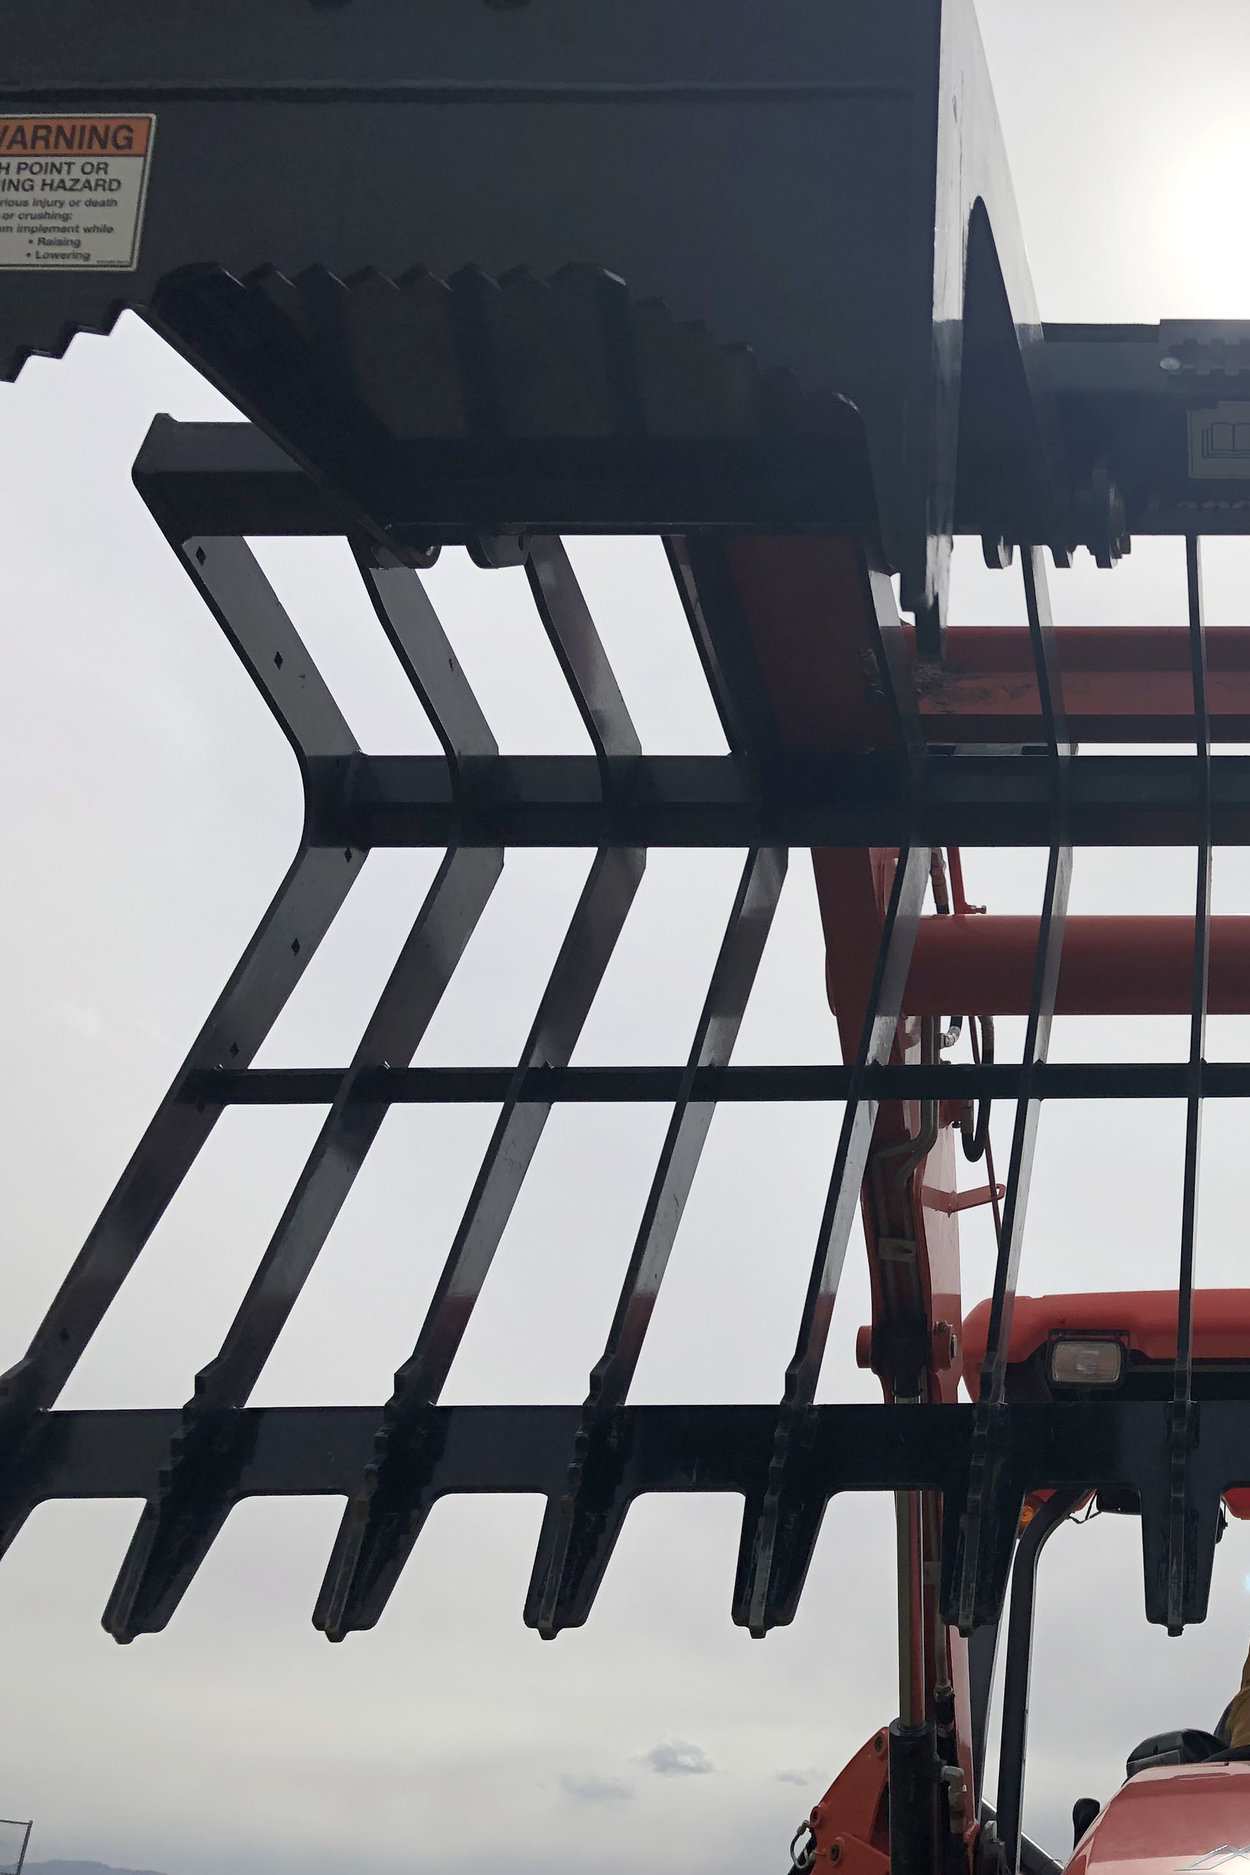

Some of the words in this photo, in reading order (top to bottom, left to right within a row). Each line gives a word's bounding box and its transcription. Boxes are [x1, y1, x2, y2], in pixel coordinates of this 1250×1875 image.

[16, 161, 75, 175] POINT
[81, 161, 109, 175] OR
[41, 178, 122, 192] HAZARD
[32, 197, 65, 209] injury
[69, 199, 81, 207] or
[84, 198, 118, 207] death
[2, 212, 15, 220] or
[18, 211, 72, 223] crushing:
[17, 224, 80, 234] implement
[83, 224, 114, 233] while
[37, 237, 81, 248] Raising
[35, 250, 91, 262] Lowering
